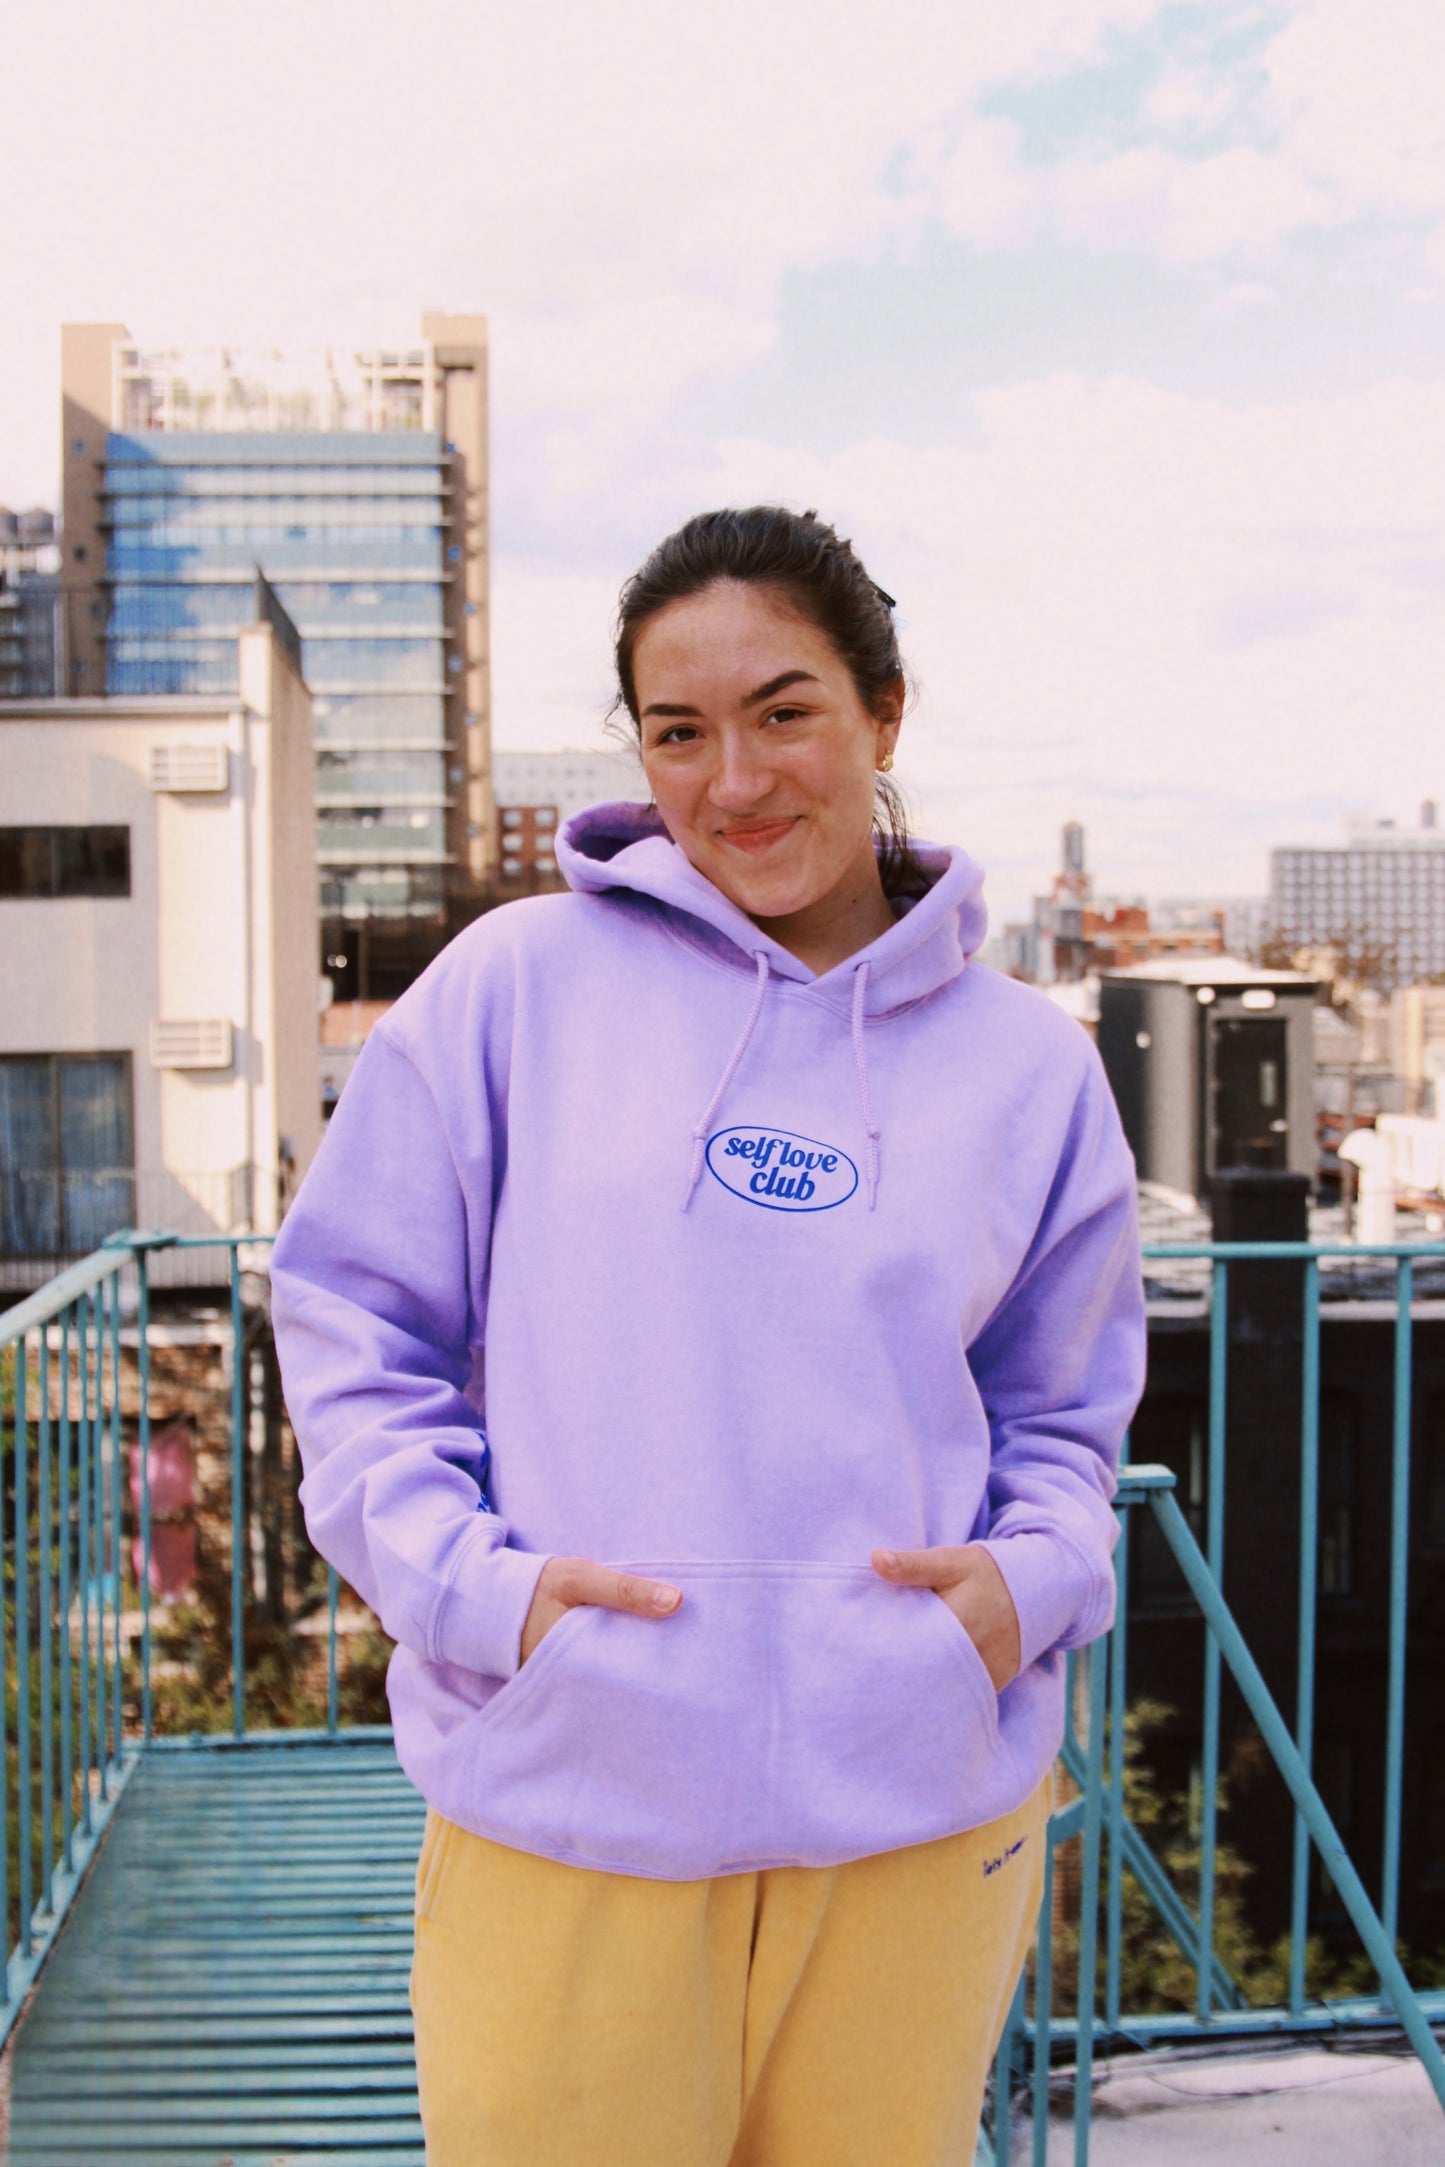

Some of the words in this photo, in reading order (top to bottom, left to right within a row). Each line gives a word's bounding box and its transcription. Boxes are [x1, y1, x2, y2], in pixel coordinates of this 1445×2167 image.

[723, 1136, 783, 1169] self
[779, 1141, 838, 1174] love
[749, 1166, 816, 1201] club
